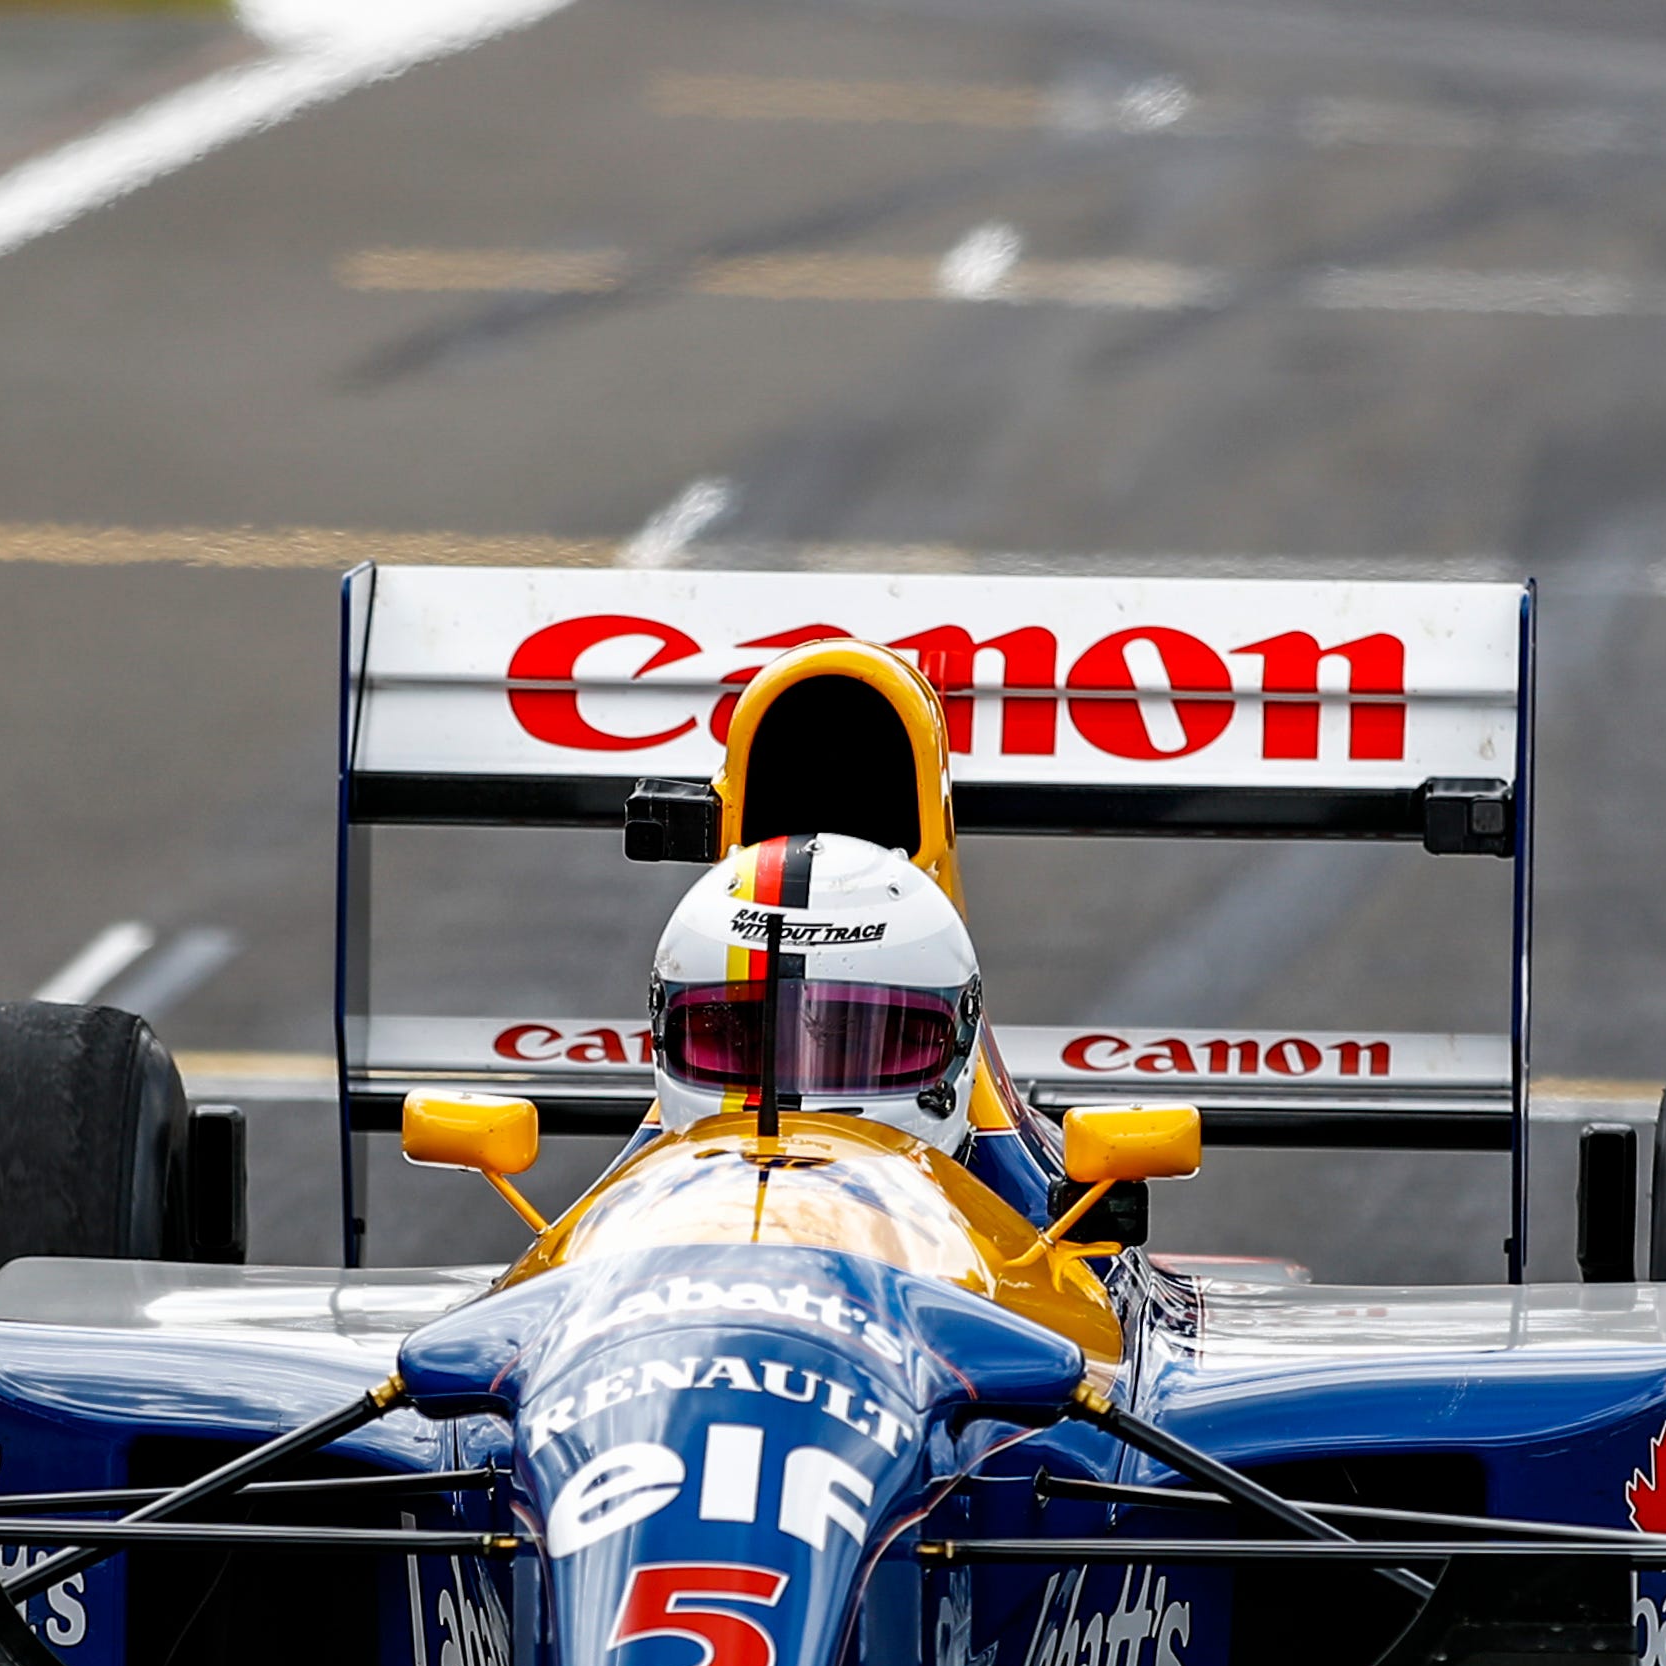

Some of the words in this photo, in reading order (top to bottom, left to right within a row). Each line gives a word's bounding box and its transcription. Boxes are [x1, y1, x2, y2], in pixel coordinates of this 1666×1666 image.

[506, 614, 1405, 761] Cnon
[824, 922, 888, 941] TRACE
[1061, 1034, 1390, 1077] Canon
[561, 1276, 904, 1364] Labatt's
[528, 1356, 914, 1458] RENAULT
[547, 1423, 875, 1559] elf
